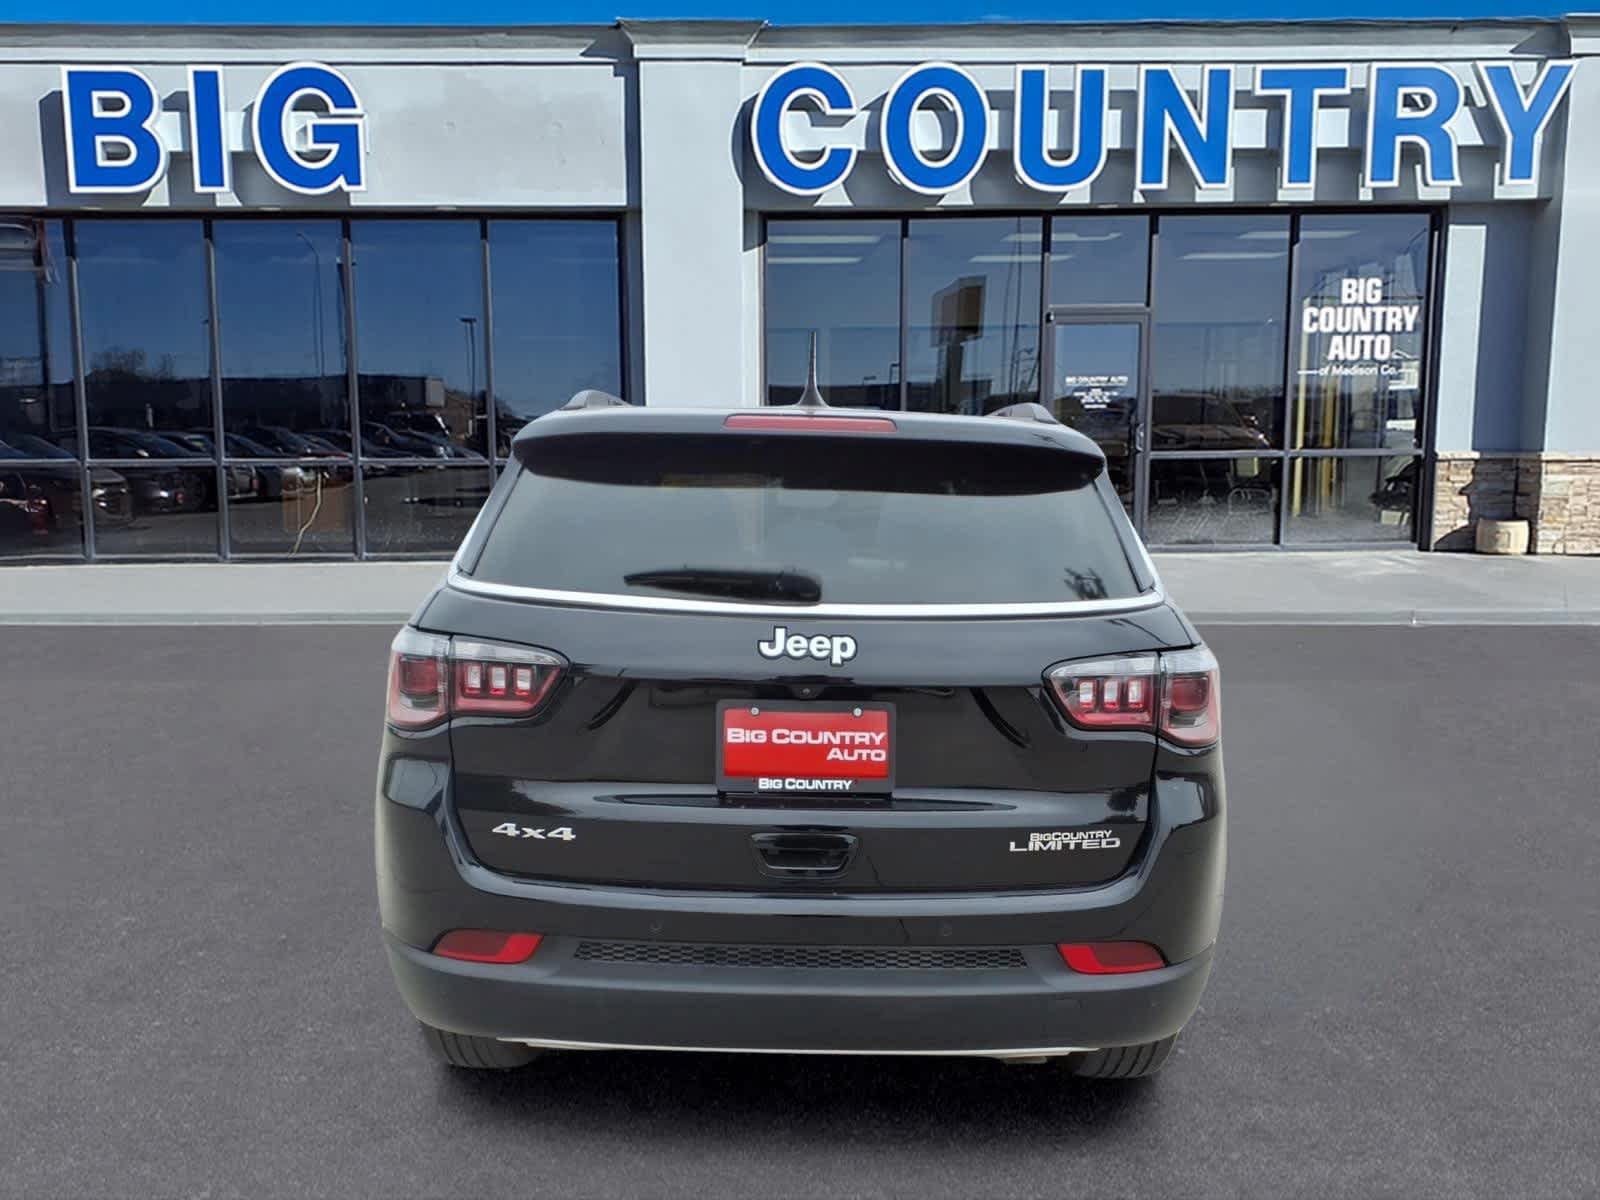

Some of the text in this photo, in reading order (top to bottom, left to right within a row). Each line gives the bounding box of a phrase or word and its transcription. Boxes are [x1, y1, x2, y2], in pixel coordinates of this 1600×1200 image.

[61, 61, 1577, 196] BIG COUNTRY
[1340, 277, 1383, 305] BIG
[1302, 304, 1420, 333] COUNTRY
[1327, 333, 1392, 361] AUTO
[1319, 365, 1330, 376] of
[1330, 364, 1378, 376] Madison
[758, 626, 857, 666] Jeep
[726, 727, 888, 746] BIG COUNTRY
[826, 747, 887, 762] AUTO
[758, 777, 853, 791] BIG COUNTRY
[1008, 837, 1122, 852] LIMITED
